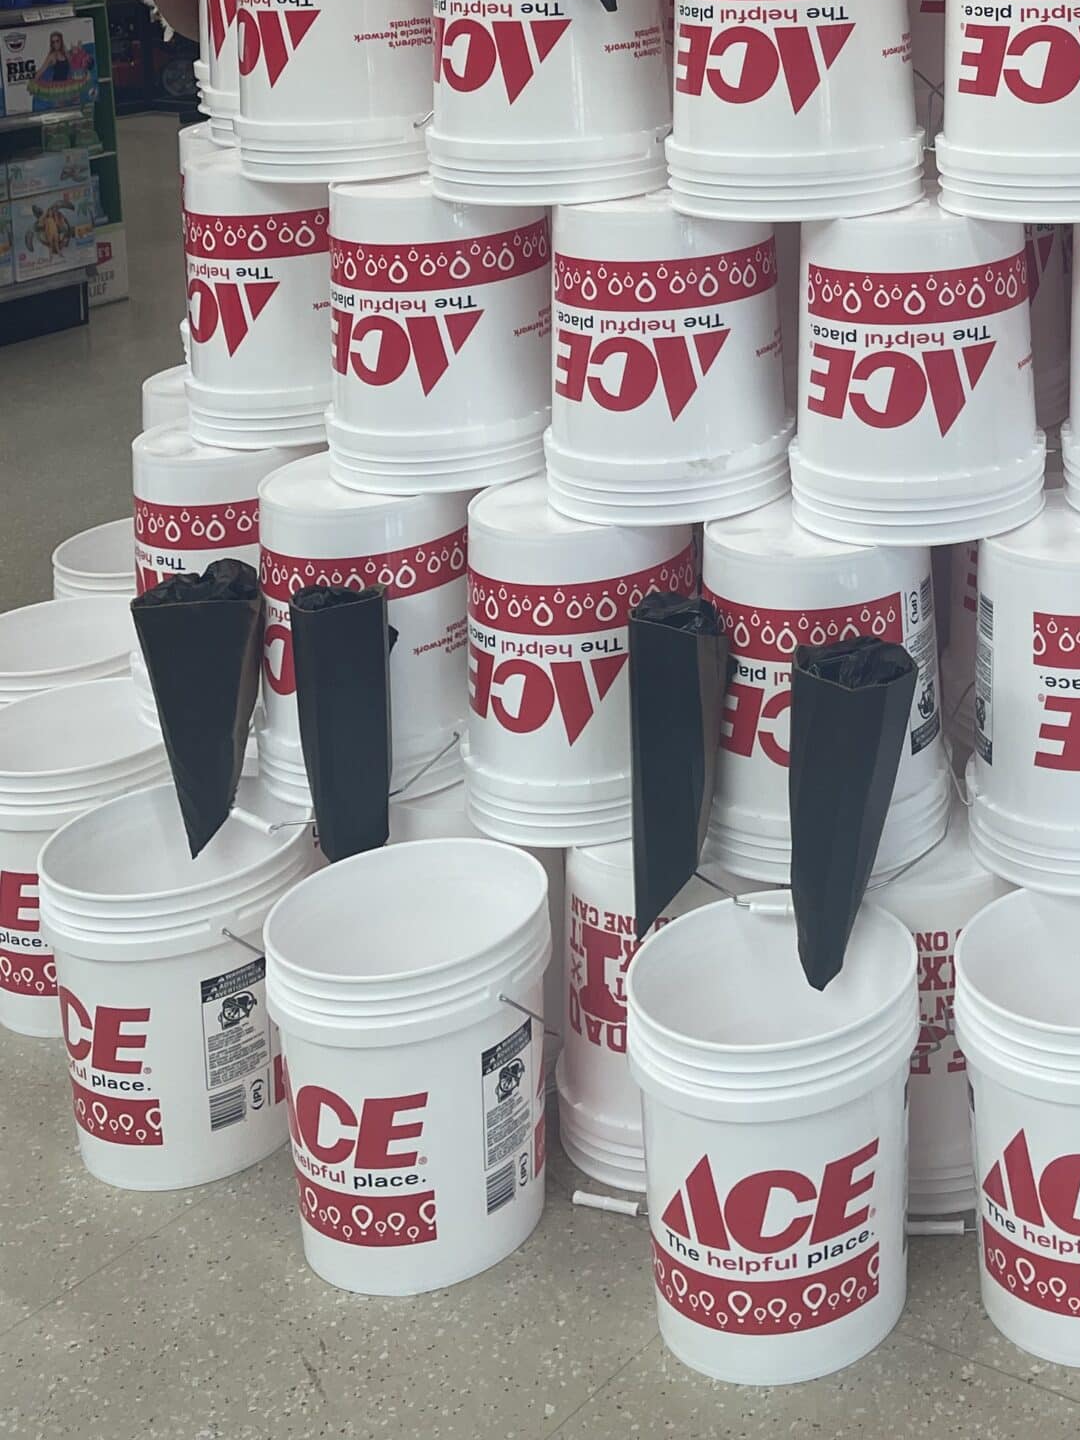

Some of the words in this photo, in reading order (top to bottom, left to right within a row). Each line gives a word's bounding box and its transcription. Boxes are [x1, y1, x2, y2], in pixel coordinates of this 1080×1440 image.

[451, 0, 512, 17] helpful
[521, 3, 564, 16] The
[721, 7, 797, 24] helpful
[807, 6, 848, 20] The
[965, 5, 1011, 21] place.
[390, 17, 431, 29] Hospitals
[354, 31, 398, 42] Network
[400, 26, 433, 38] Miracle
[389, 36, 433, 48] Children's
[7, 60, 36, 74] BIG
[674, 22, 855, 114] ACE
[236, 267, 273, 279] The
[360, 298, 426, 313] helpful
[435, 295, 477, 309] The
[601, 318, 675, 334] helpful
[684, 314, 724, 328] The
[814, 325, 856, 344] place.
[865, 331, 944, 348] helpful
[953, 325, 991, 341] The
[332, 308, 482, 398] ACE
[556, 329, 730, 421] ACE
[808, 342, 996, 436] ACE
[502, 640, 572, 658] helpful
[581, 638, 623, 653] The
[468, 648, 628, 744] ACE
[571, 893, 599, 927] CAN
[92, 1074, 151, 1091] place.
[354, 1173, 426, 1190] place.
[661, 1137, 879, 1254] ACE
[986, 1198, 1016, 1233] The
[666, 1230, 699, 1261] The
[707, 1251, 797, 1275] helpful
[807, 1230, 874, 1268] place.
